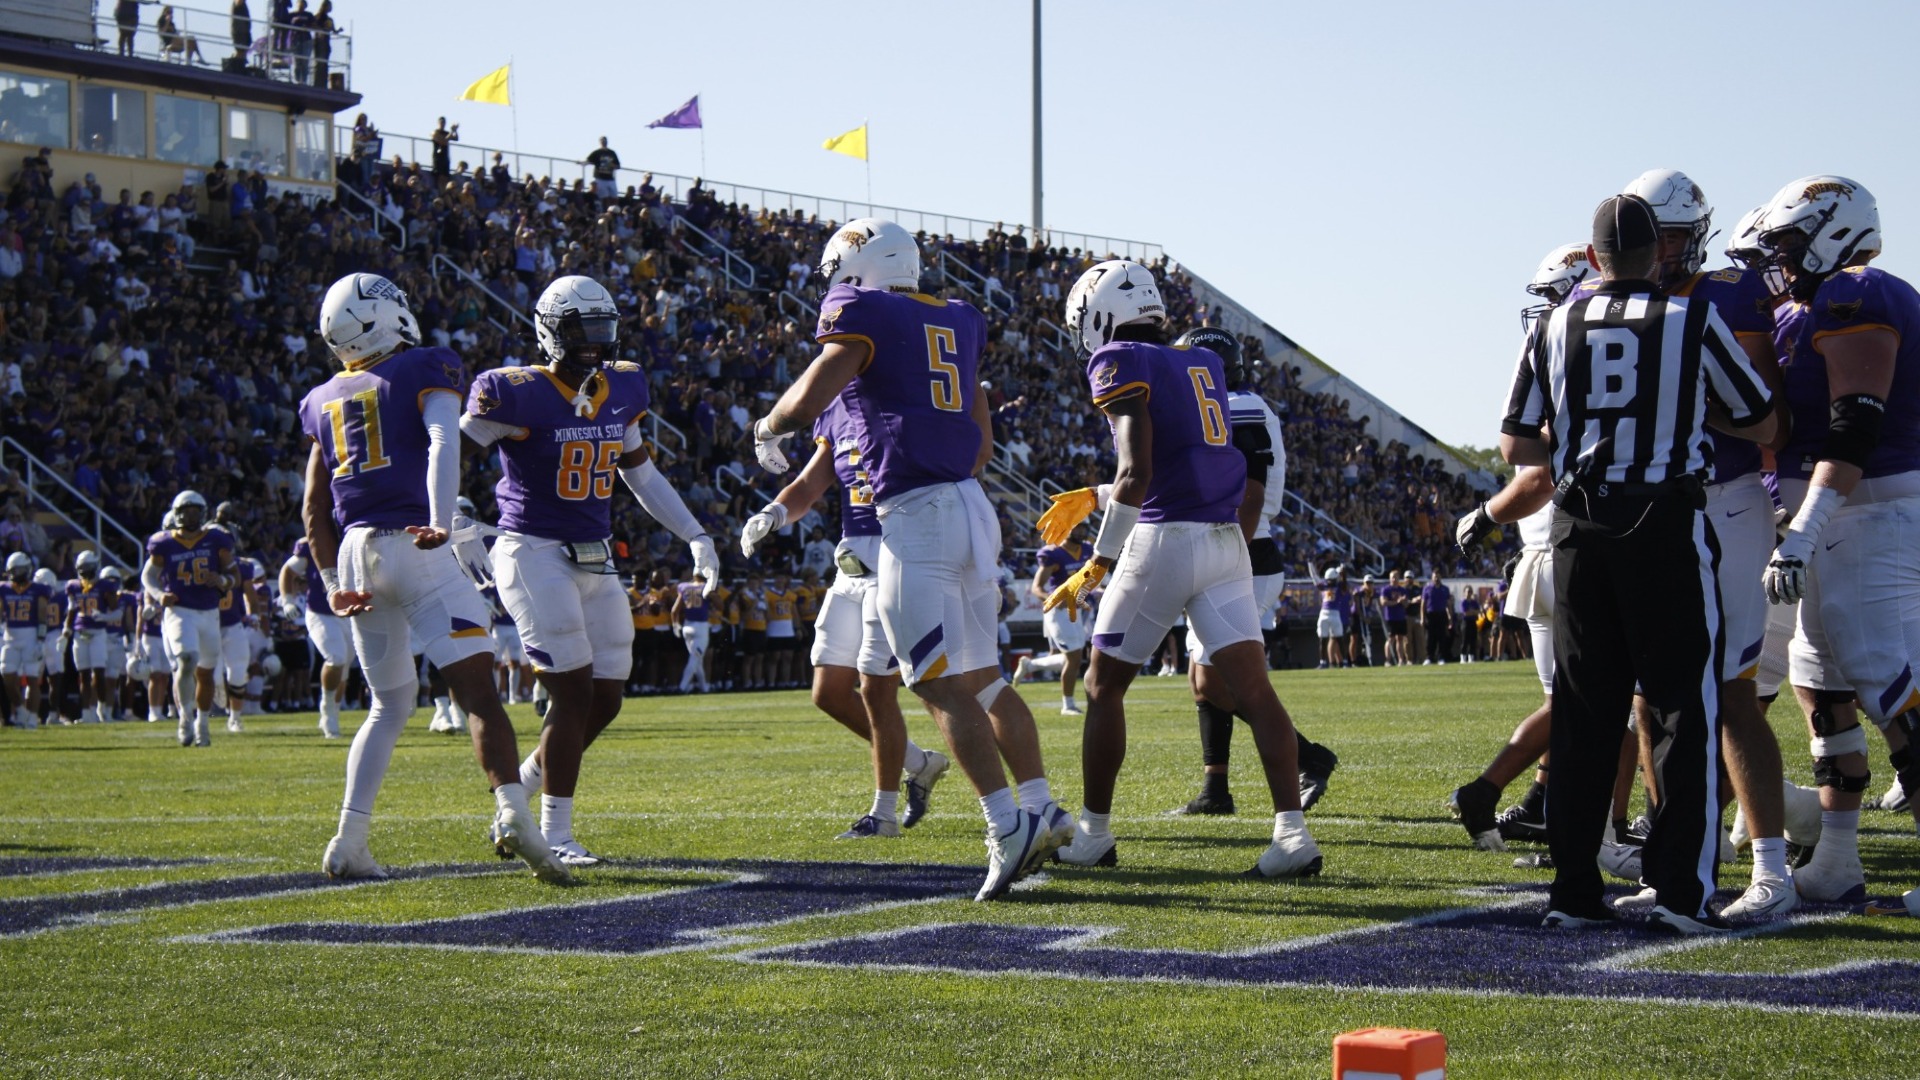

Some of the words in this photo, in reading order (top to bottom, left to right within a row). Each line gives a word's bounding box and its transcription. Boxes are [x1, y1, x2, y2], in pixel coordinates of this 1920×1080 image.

[1188, 331, 1233, 346] Cougars
[924, 323, 963, 413] 5
[1586, 327, 1639, 410] B
[1187, 366, 1228, 446] 6
[321, 386, 391, 477] 11
[554, 426, 602, 442] MINNESOTA
[605, 423, 624, 438] STATE
[556, 440, 624, 500] 85
[1598, 484, 1608, 497] S
[177, 557, 209, 586] 46
[7, 601, 31, 621] 12
